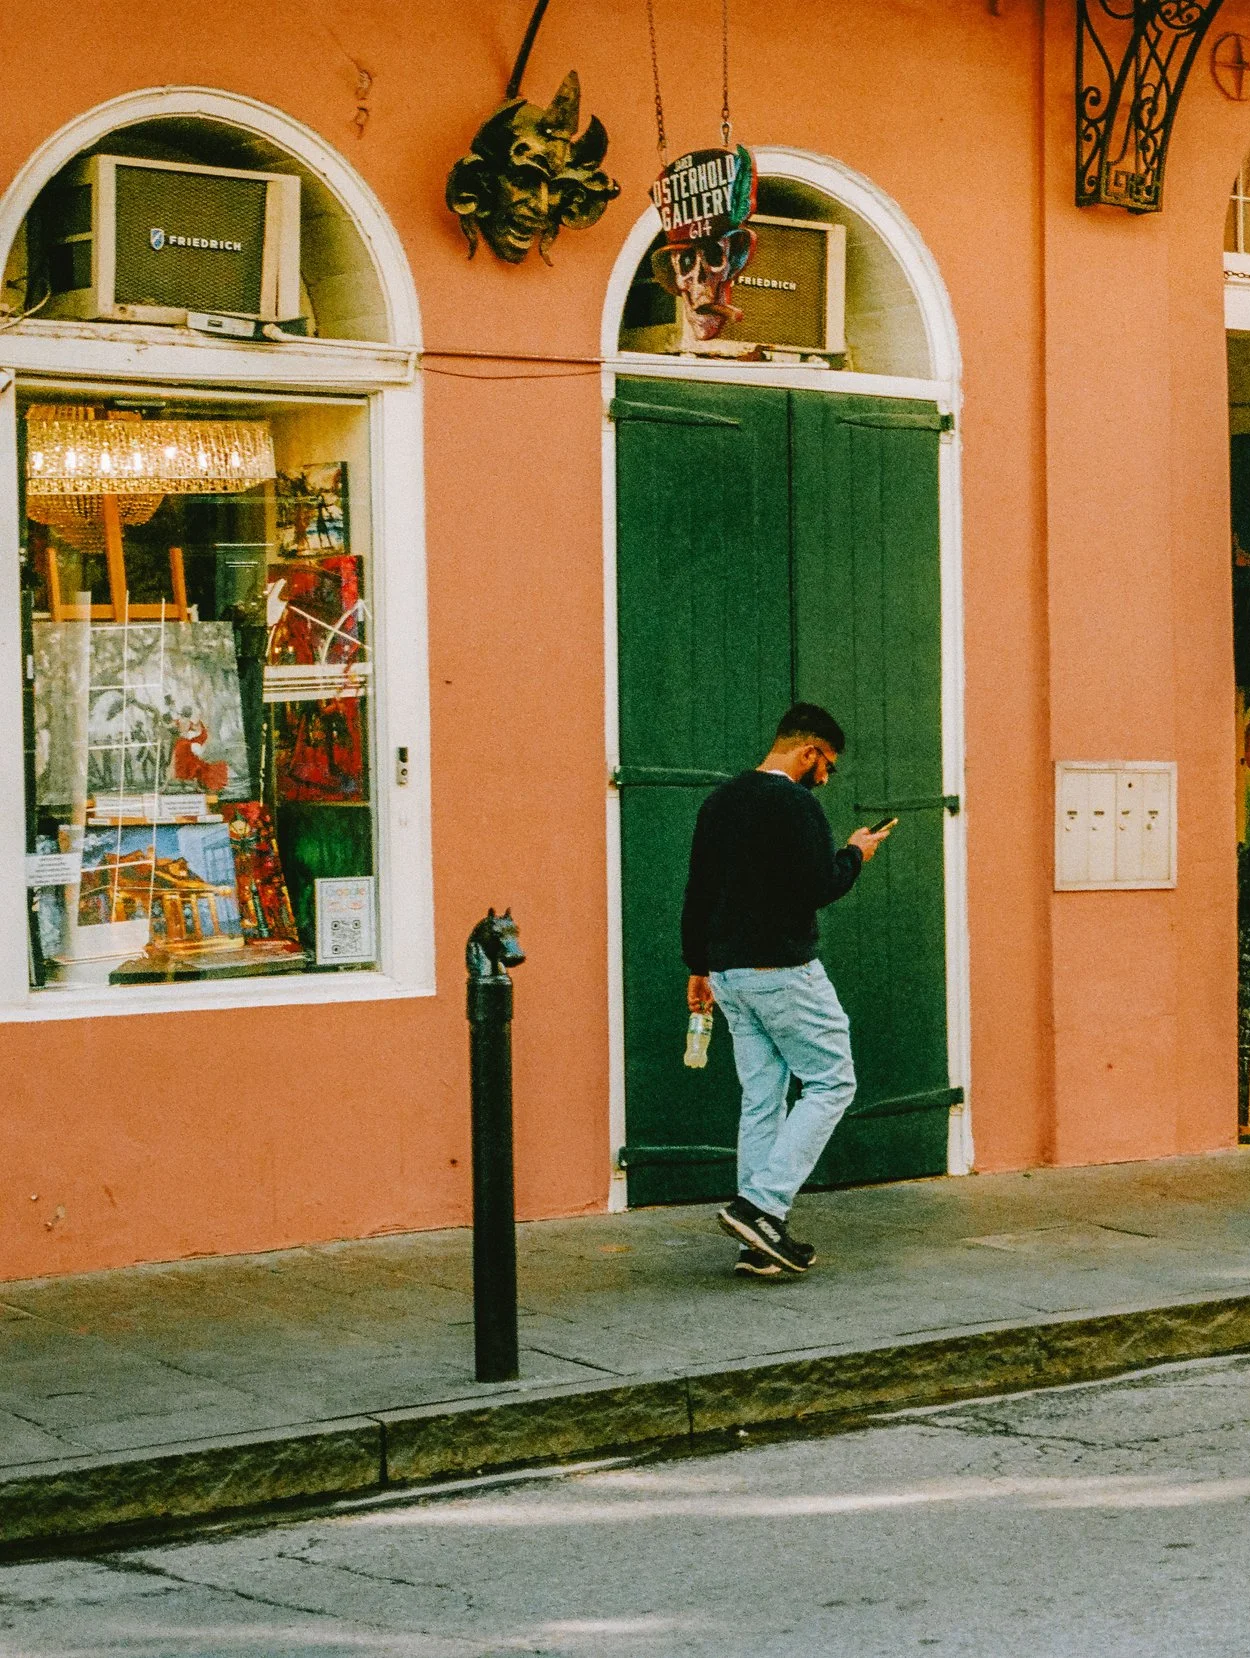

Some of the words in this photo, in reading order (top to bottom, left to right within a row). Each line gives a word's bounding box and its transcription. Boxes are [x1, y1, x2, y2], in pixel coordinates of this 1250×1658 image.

[653, 154, 736, 207] OSTERHOLD
[661, 184, 732, 232] GALLERY
[168, 235, 242, 251] FRIEDRICH
[737, 275, 797, 291] FRIEDRICH
